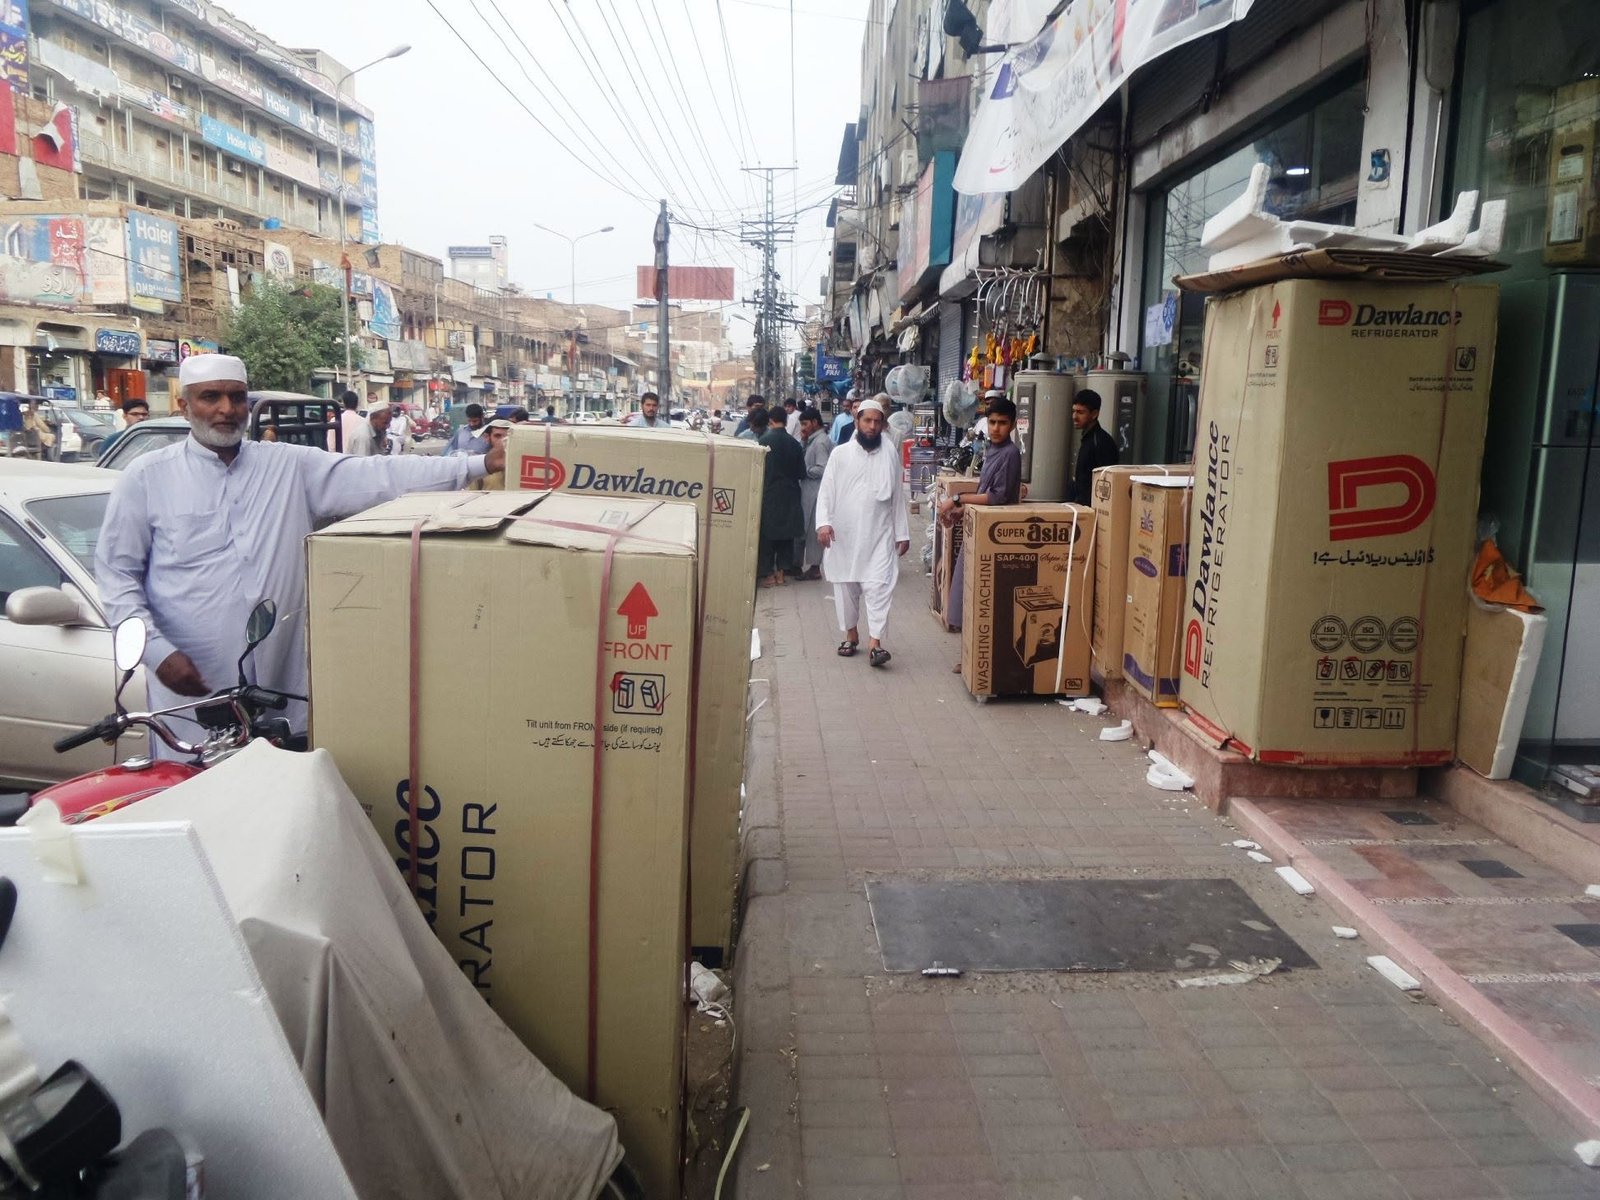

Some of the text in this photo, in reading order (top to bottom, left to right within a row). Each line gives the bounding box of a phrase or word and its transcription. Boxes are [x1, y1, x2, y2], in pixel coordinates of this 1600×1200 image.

[266, 93, 290, 118] Haier
[135, 217, 173, 246] Haier
[1353, 302, 1462, 327] Dawlance
[1351, 328, 1438, 338] REFRIGERATOR
[567, 463, 704, 499] Dawlance
[996, 523, 1069, 542] SUPER asia
[1192, 420, 1219, 622] Dawlance
[997, 554, 1036, 562] SAP-400
[1201, 434, 1231, 689] REFRIGERATOR
[628, 624, 646, 635] UP
[977, 553, 992, 691] WASHING MACHINE
[604, 641, 673, 661] FRONT
[526, 719, 663, 735] Tilt unit from FRON side (if required)
[459, 803, 497, 1005] RATOR
